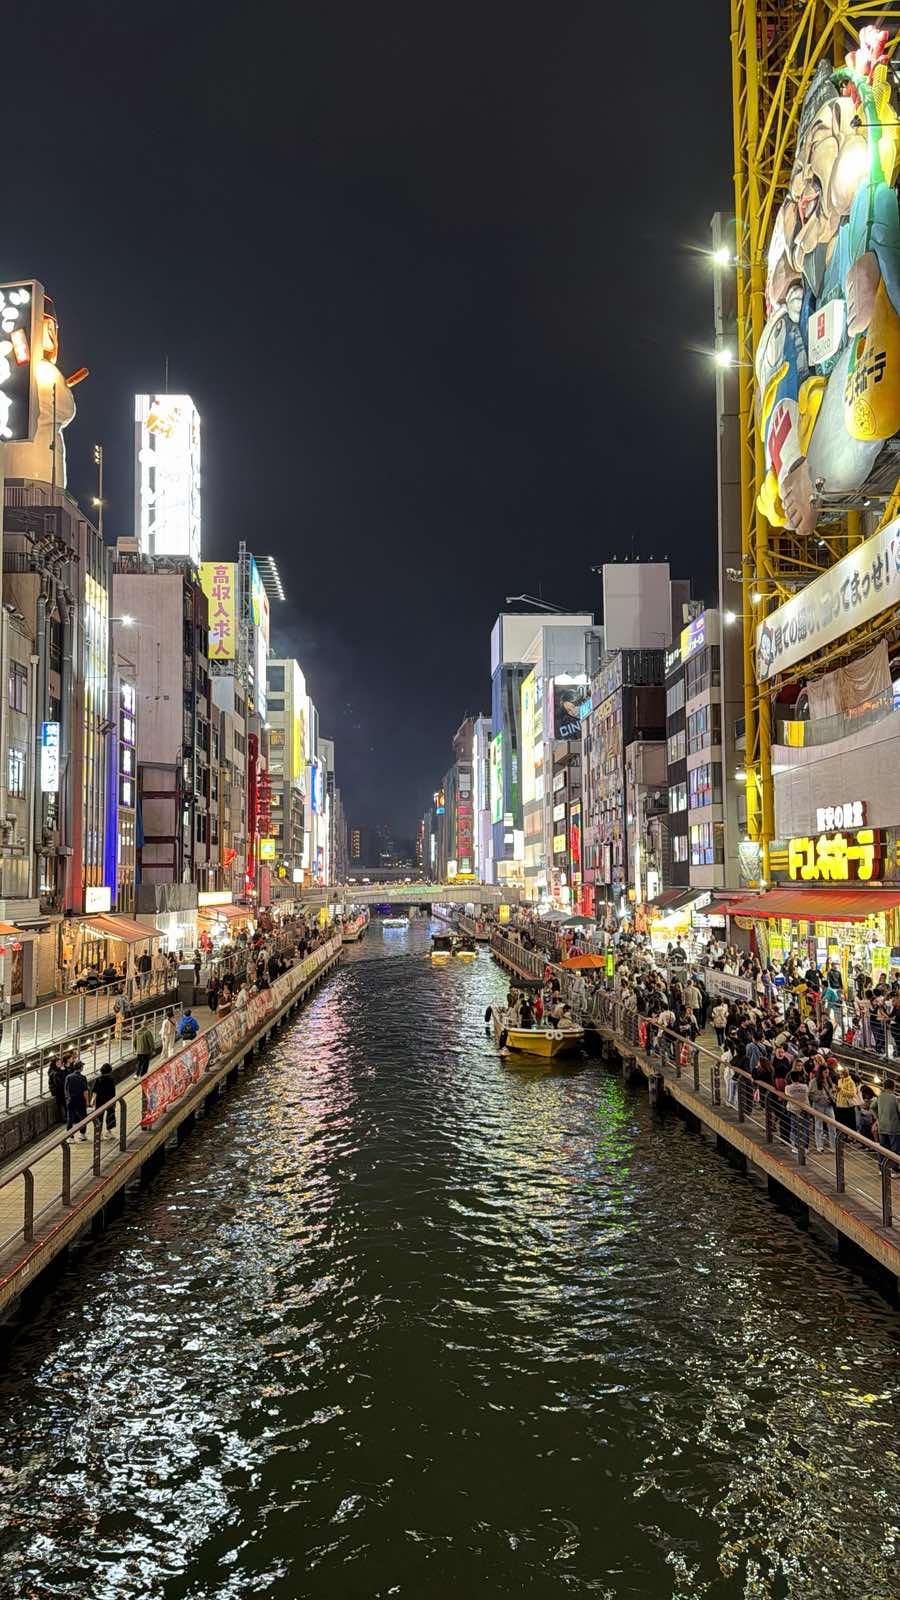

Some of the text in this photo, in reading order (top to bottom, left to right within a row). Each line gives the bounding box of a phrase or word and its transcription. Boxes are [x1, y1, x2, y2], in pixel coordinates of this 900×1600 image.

[212, 565, 231, 656] 高収入求人
